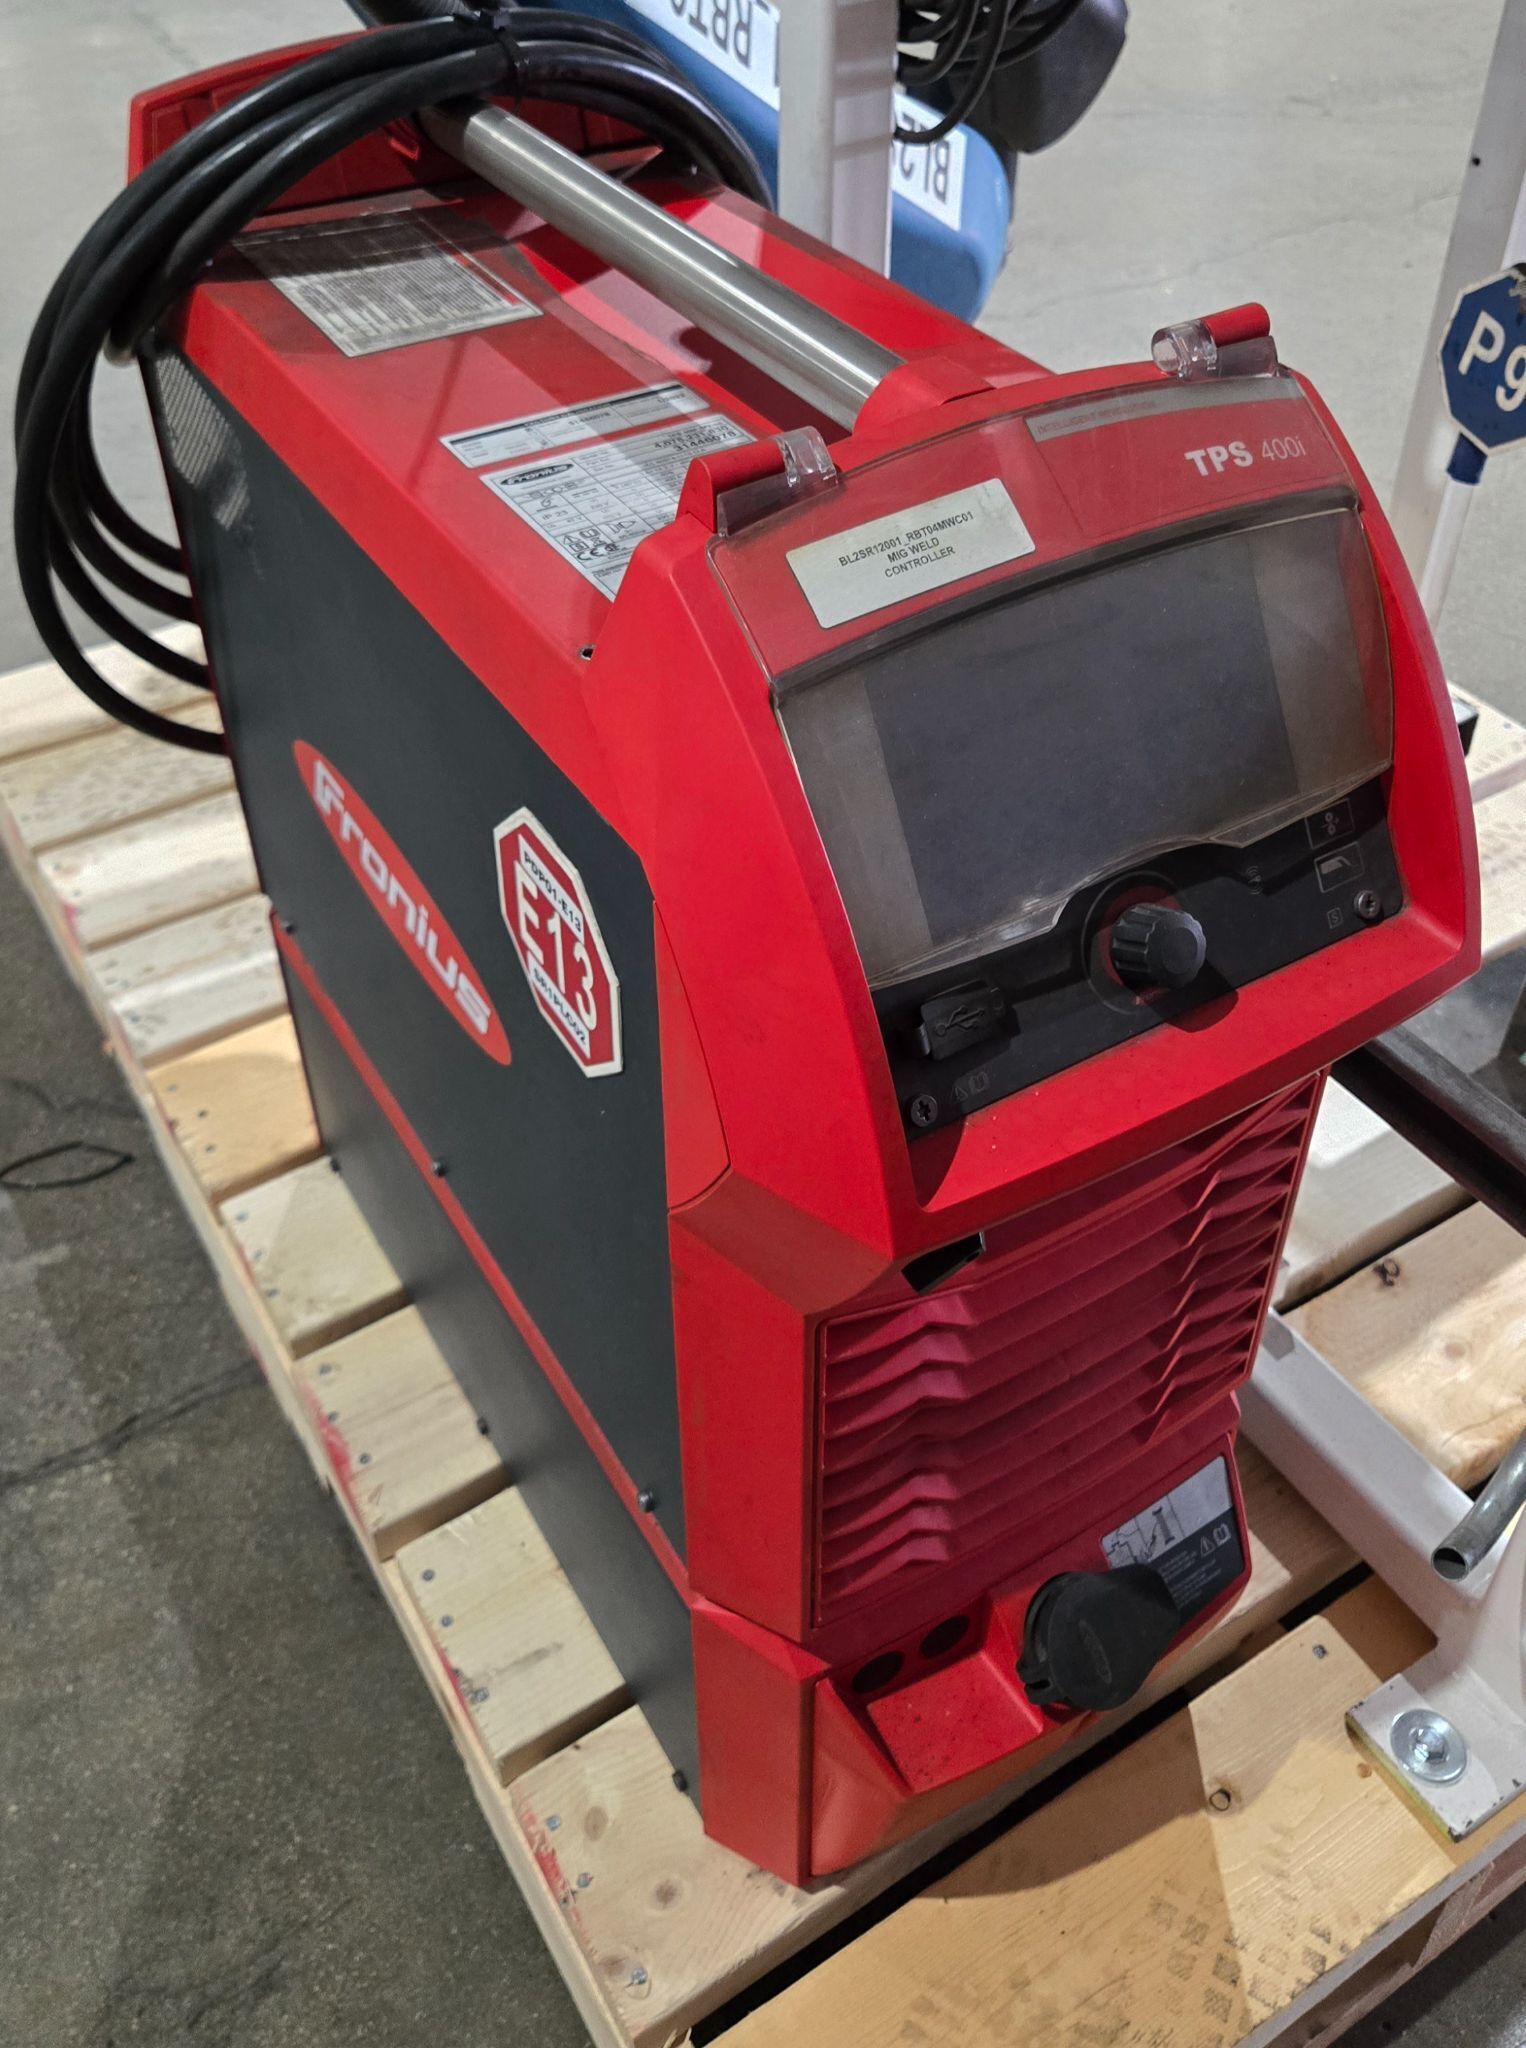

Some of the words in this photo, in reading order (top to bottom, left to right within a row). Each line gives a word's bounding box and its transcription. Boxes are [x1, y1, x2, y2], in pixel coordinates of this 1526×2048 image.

[1184, 441, 1253, 476] TPS
[1261, 436, 1307, 461] 400i
[838, 511, 975, 566] BL2SR12001_RBT04MWC01
[884, 546, 956, 578] CONTROLLER
[887, 547, 909, 563] MIG
[909, 537, 940, 556] WELD
[313, 759, 492, 1034] Fronius
[524, 851, 582, 932] PDP01-E13
[514, 860, 597, 1031] E13
